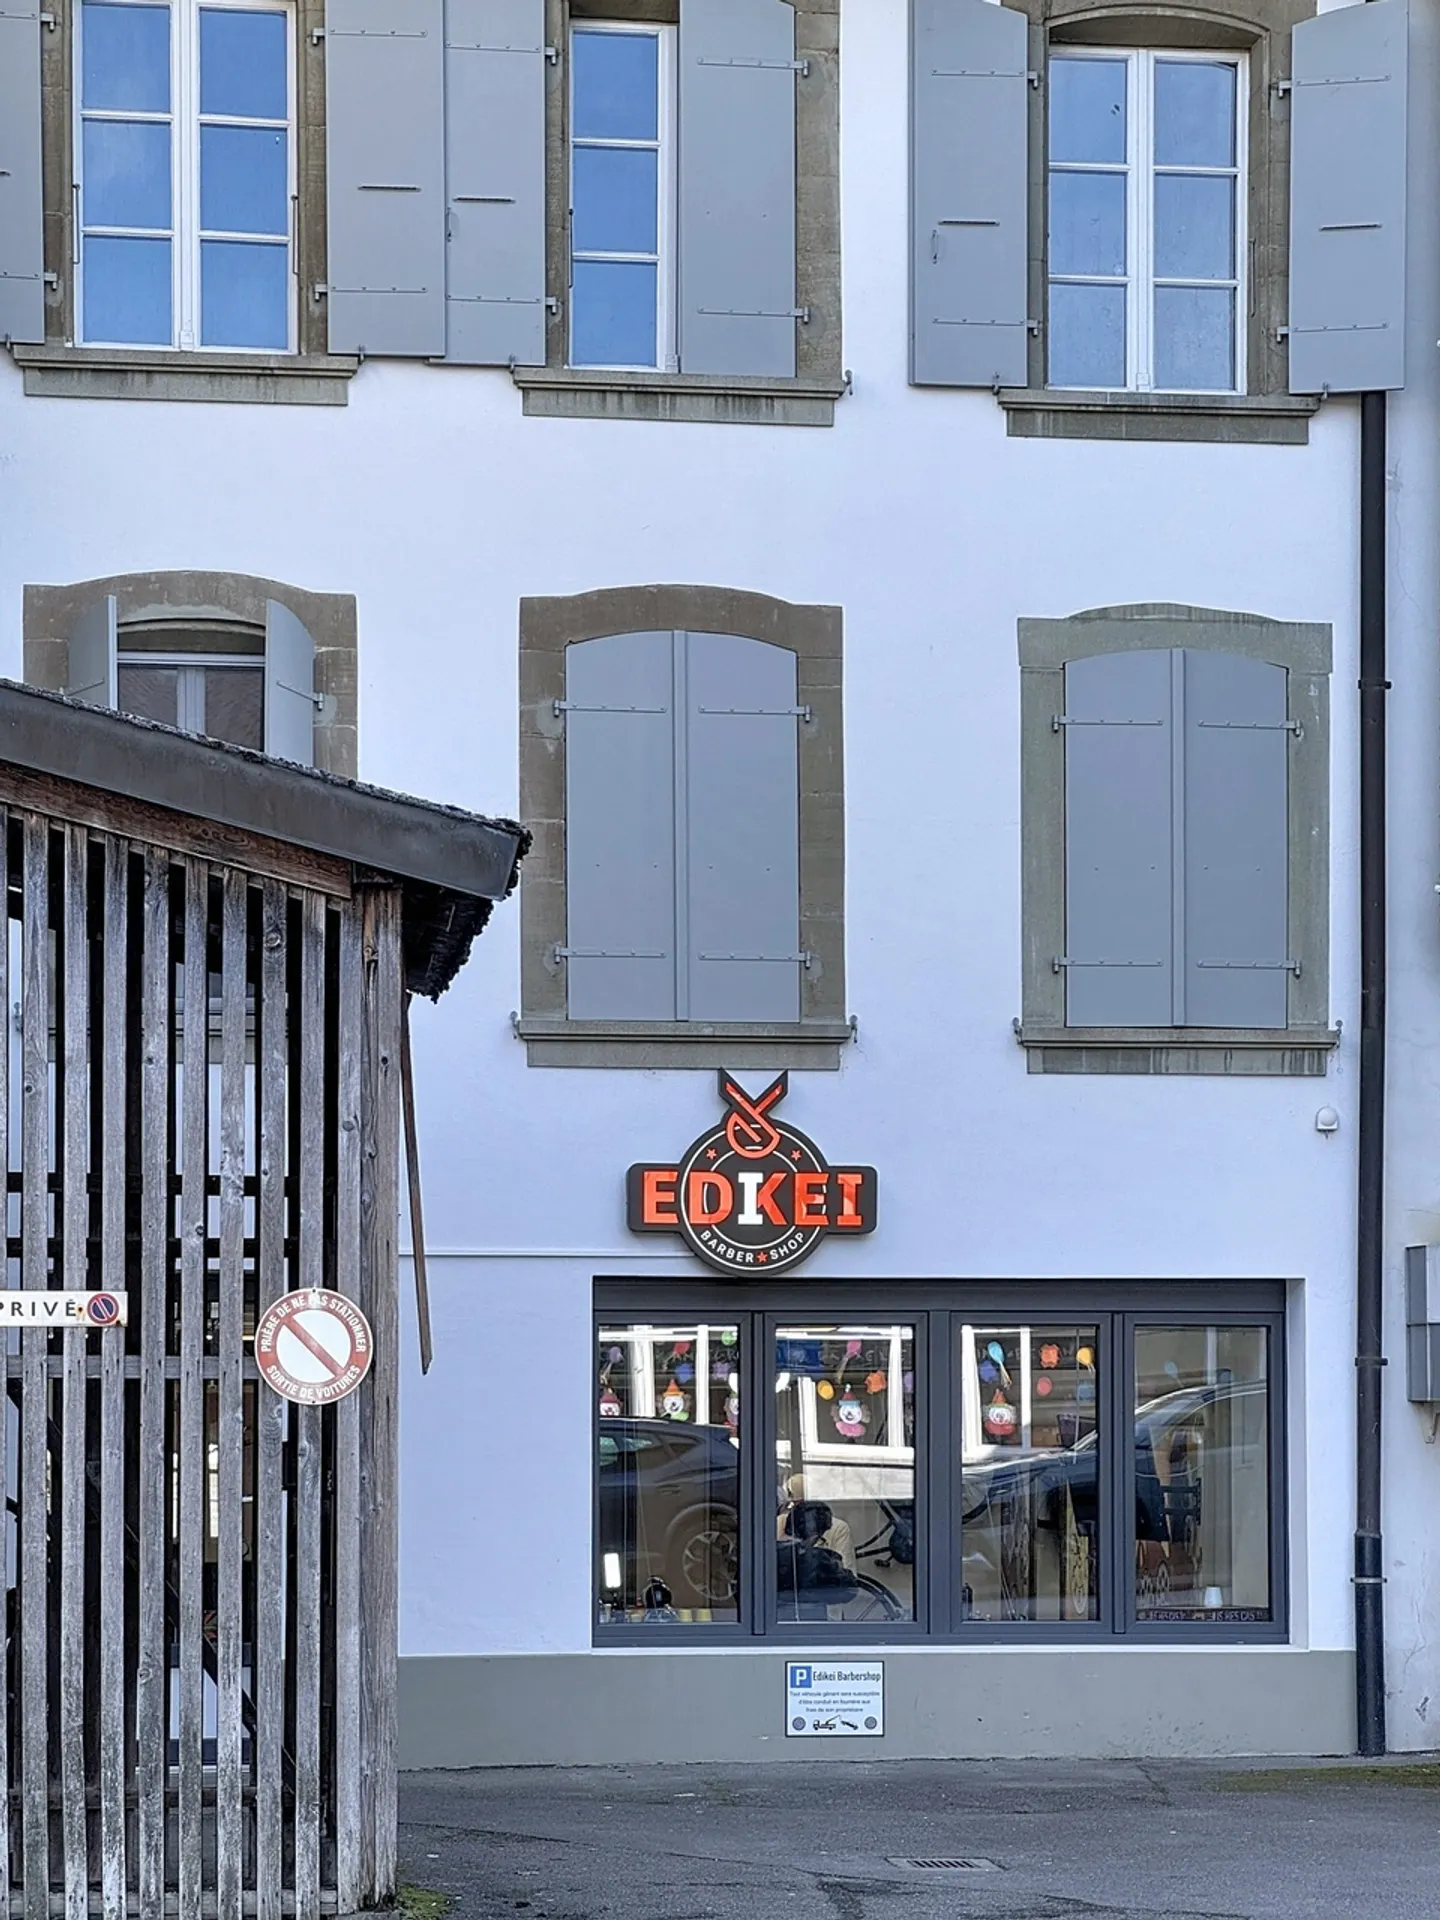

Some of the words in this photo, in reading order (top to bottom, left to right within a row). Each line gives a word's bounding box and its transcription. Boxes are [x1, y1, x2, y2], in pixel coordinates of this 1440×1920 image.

[643, 1171, 863, 1226] EDIKEI
[700, 1229, 754, 1263] BARBER
[770, 1232, 805, 1260] SHOP
[261, 1315, 280, 1352] PRIÈRE
[276, 1302, 292, 1317] DE
[291, 1295, 306, 1308] NE
[329, 1298, 367, 1352] STATIONNER
[267, 1365, 298, 1395] SORTIE
[300, 1388, 315, 1399] DE
[315, 1365, 360, 1399] VOITURES
[796, 1669, 807, 1686] P
[813, 1671, 836, 1681] Edikei
[837, 1671, 881, 1682] Barbershop
